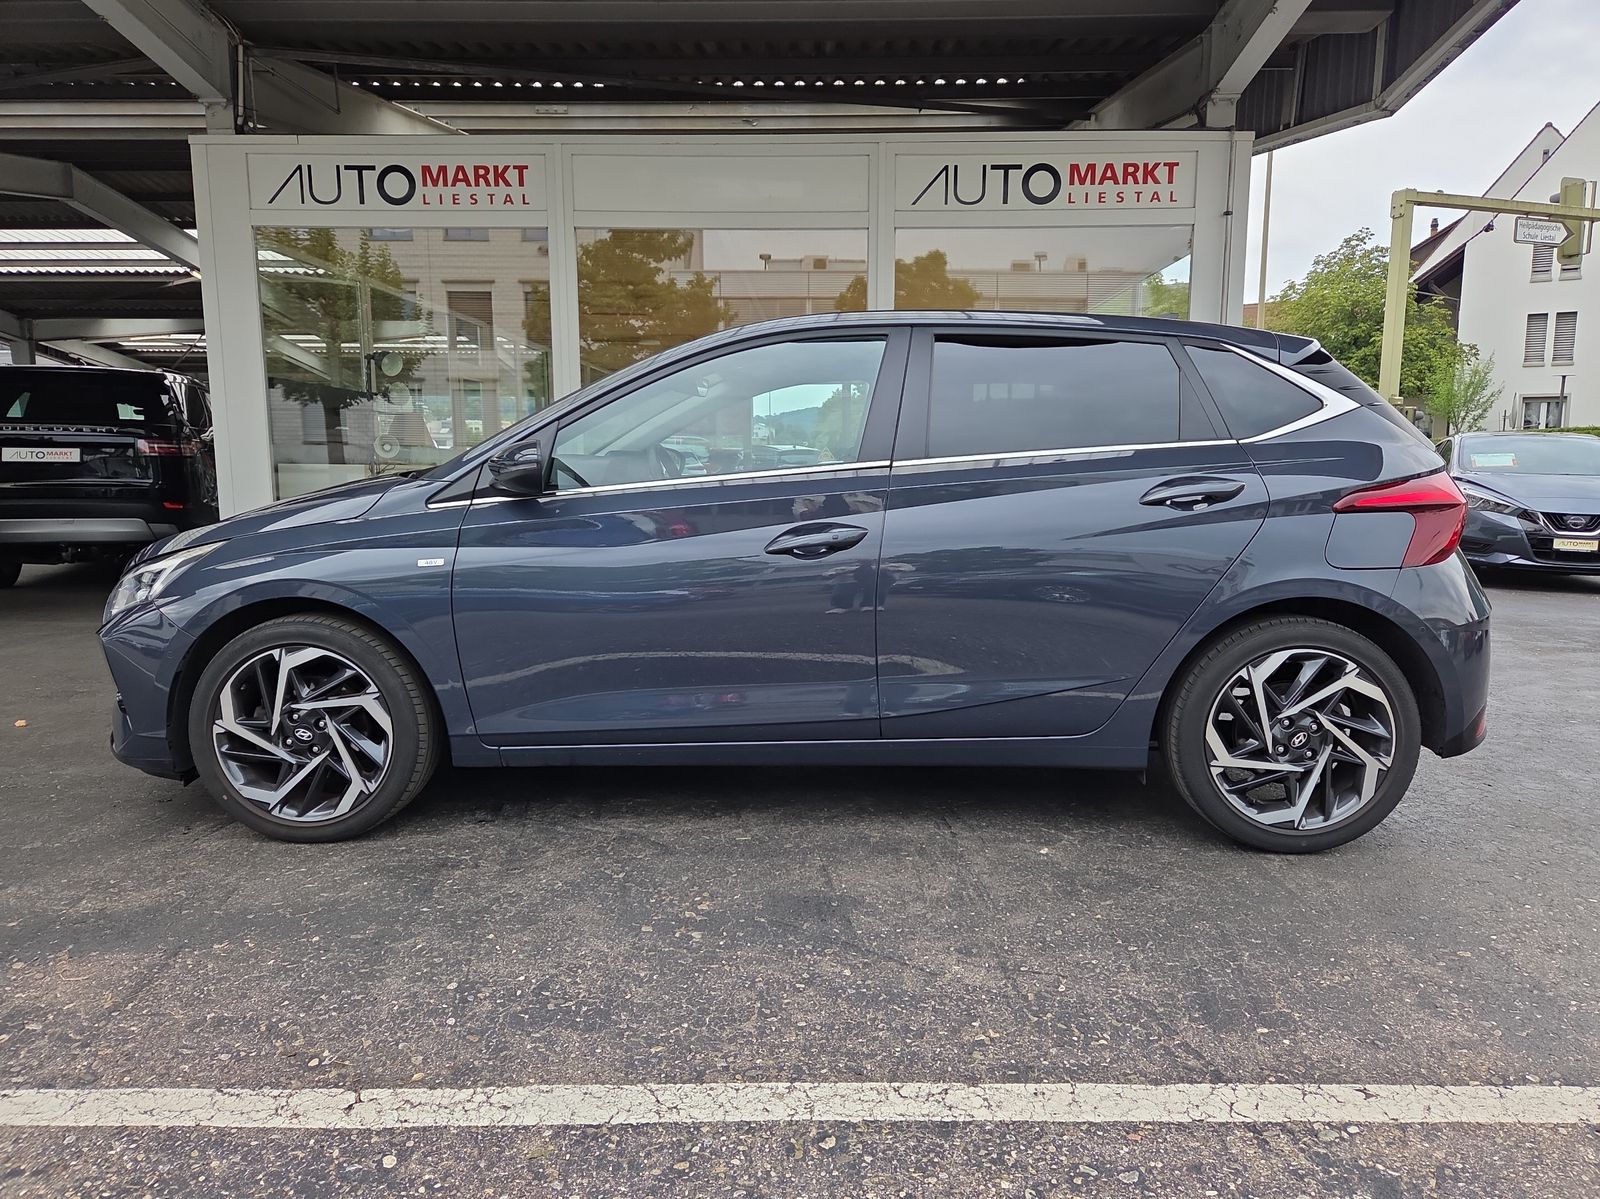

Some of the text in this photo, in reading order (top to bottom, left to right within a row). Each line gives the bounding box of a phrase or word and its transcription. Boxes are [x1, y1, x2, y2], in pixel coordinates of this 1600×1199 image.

[267, 164, 529, 206] AUTO MARKT
[911, 162, 1180, 206] AUTO MARKT
[422, 193, 530, 206] LIESTAL
[1067, 191, 1178, 204] LIESTAL
[1523, 231, 1556, 241] Schule Liestal
[2, 425, 120, 433] DISCOVERY
[9, 451, 46, 460] AUTO
